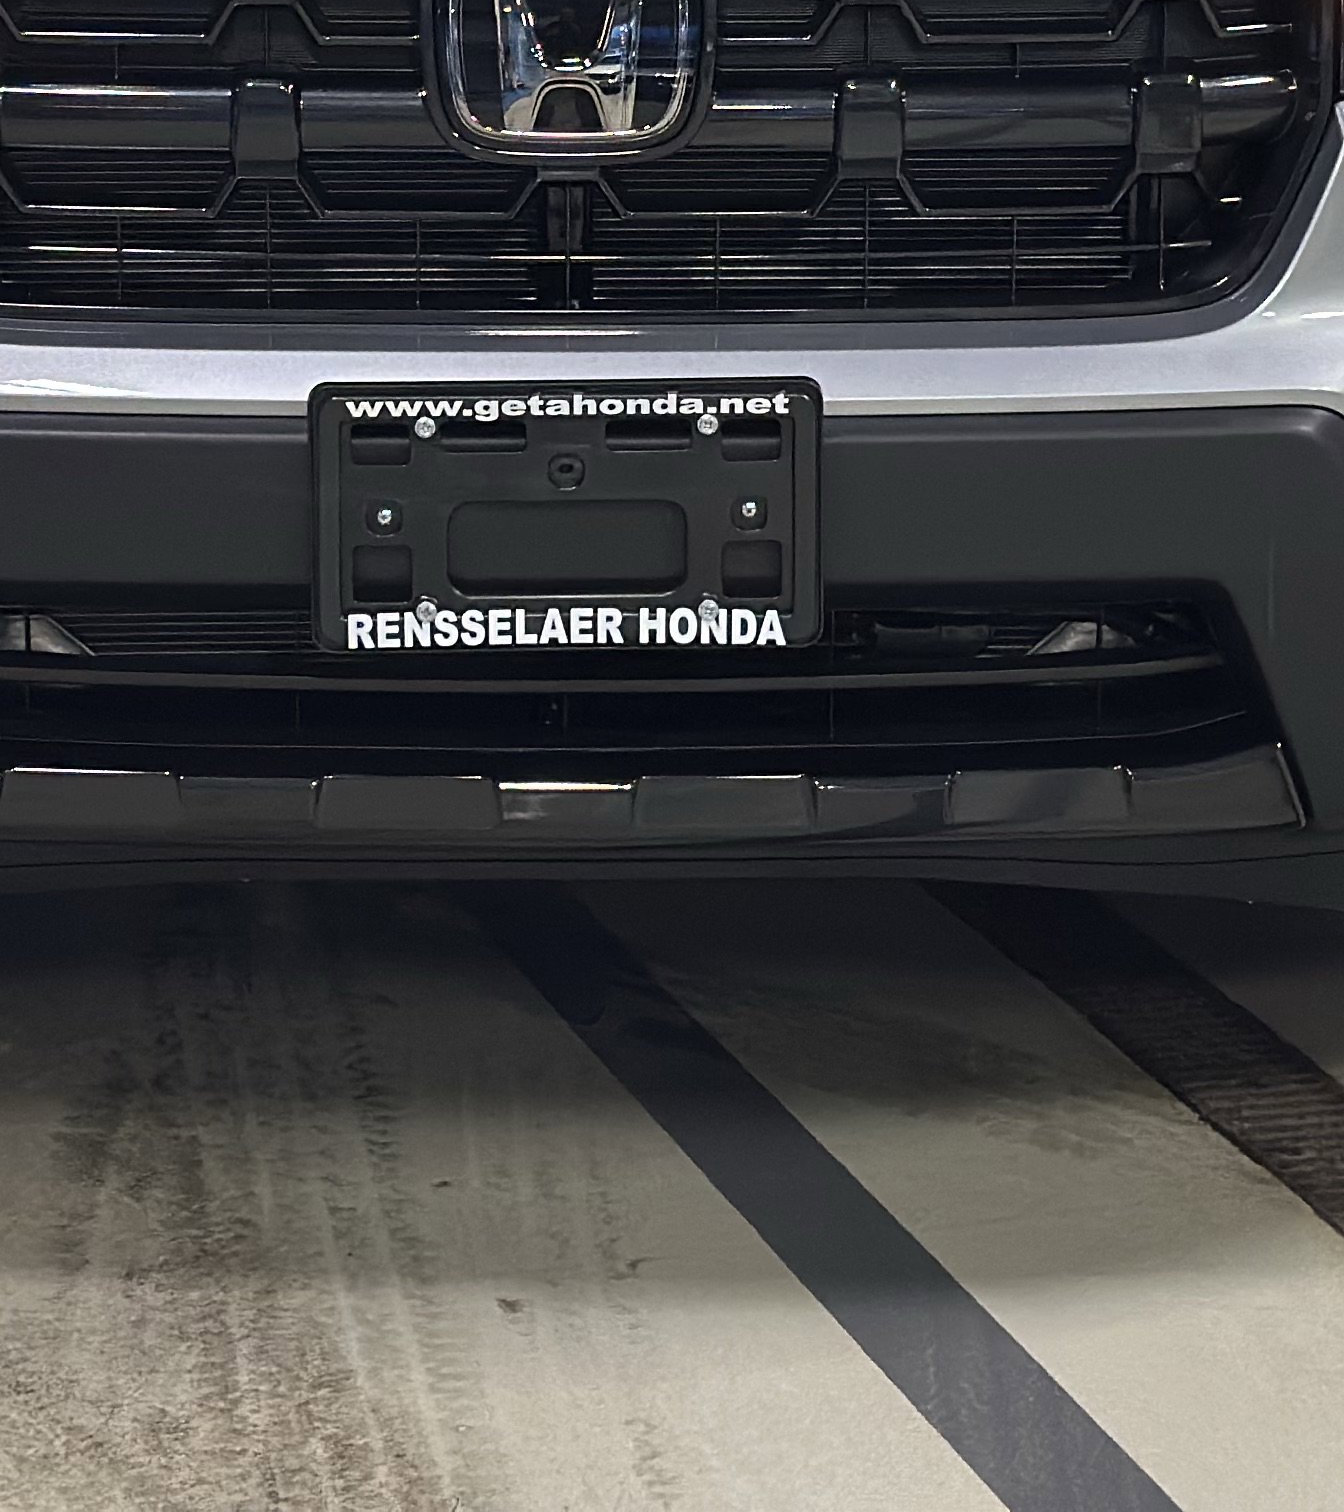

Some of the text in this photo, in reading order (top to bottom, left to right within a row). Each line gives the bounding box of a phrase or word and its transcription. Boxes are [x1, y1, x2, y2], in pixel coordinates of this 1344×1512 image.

[346, 391, 790, 421] www.getahonda.net
[346, 607, 787, 650] RENSSELAER HONDA
